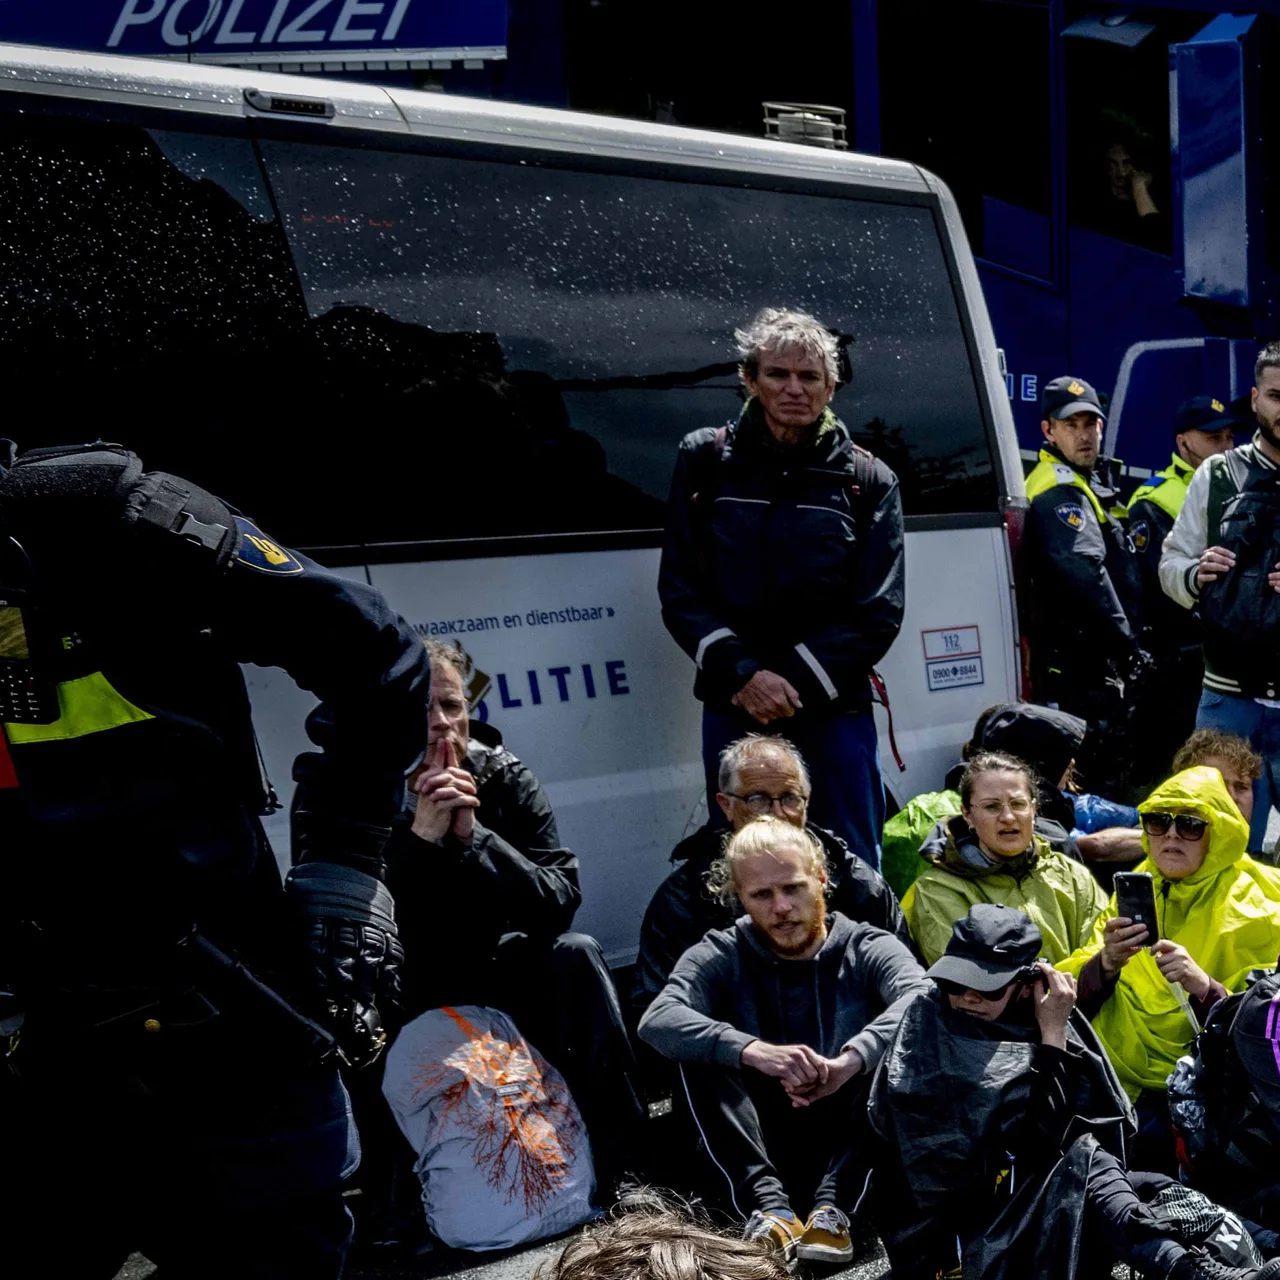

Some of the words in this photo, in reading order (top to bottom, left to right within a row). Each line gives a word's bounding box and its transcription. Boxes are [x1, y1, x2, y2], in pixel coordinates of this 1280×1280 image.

[107, 0, 411, 47] POLIZEI
[413, 615, 500, 638] waakzaam
[503, 616, 523, 629] en
[525, 605, 603, 628] dienstbaar
[943, 633, 960, 649] 112
[932, 667, 951, 680] 0900
